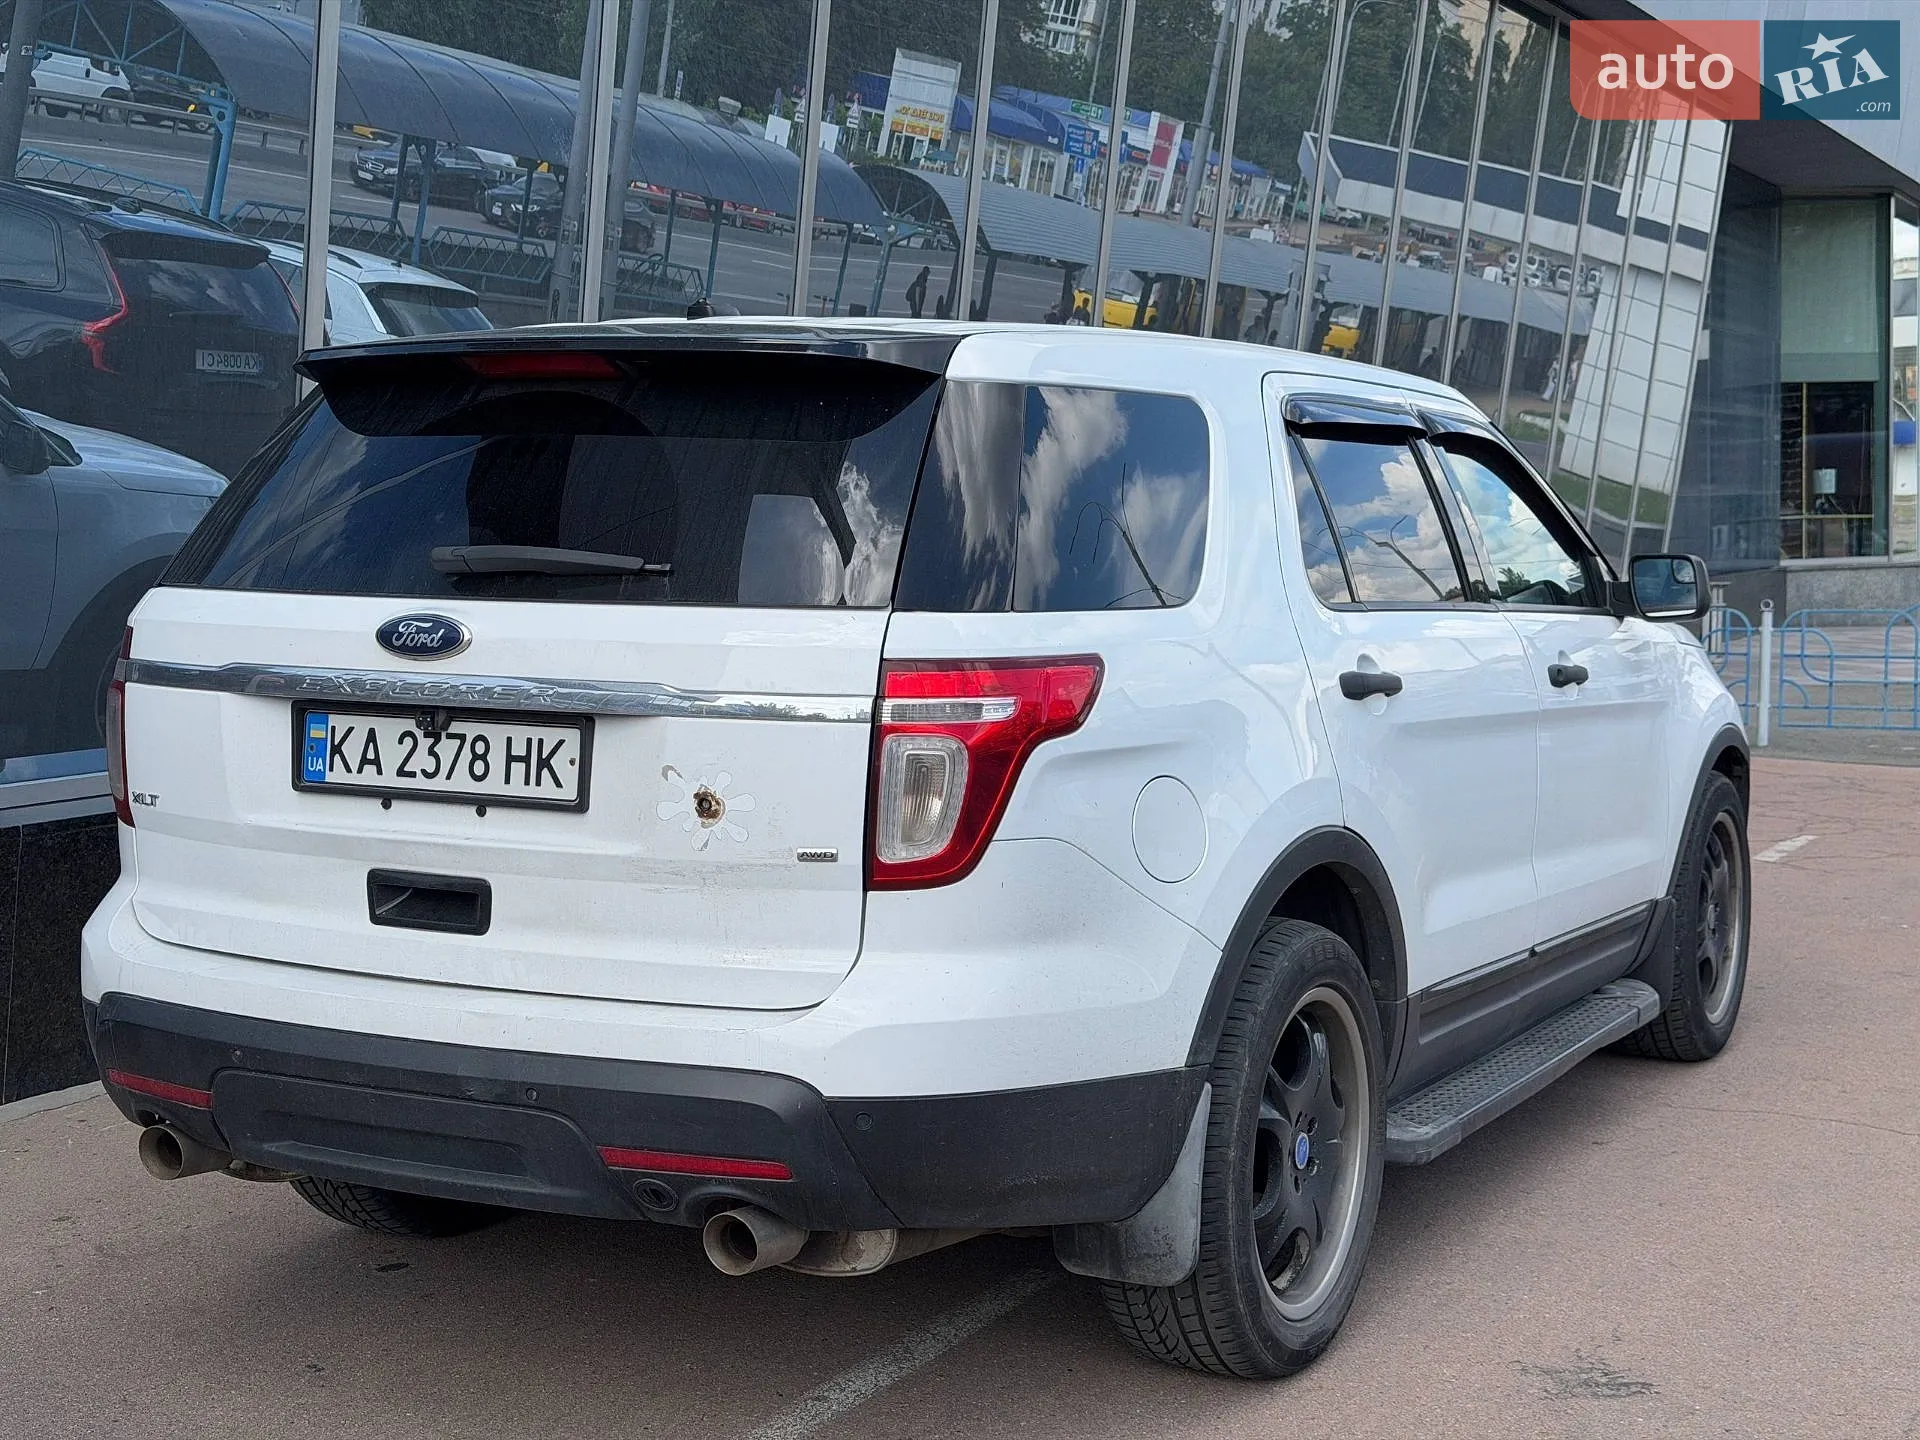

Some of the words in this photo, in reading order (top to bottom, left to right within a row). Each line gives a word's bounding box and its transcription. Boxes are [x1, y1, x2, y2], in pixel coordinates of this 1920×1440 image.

[392, 620, 445, 648] Ford
[296, 676, 559, 703] EXPLORER
[308, 756, 325, 772] UA
[328, 725, 383, 776] KA
[396, 730, 490, 783] 2378
[504, 736, 566, 789] HK
[131, 790, 160, 807] XLT
[799, 851, 835, 859] AWD
